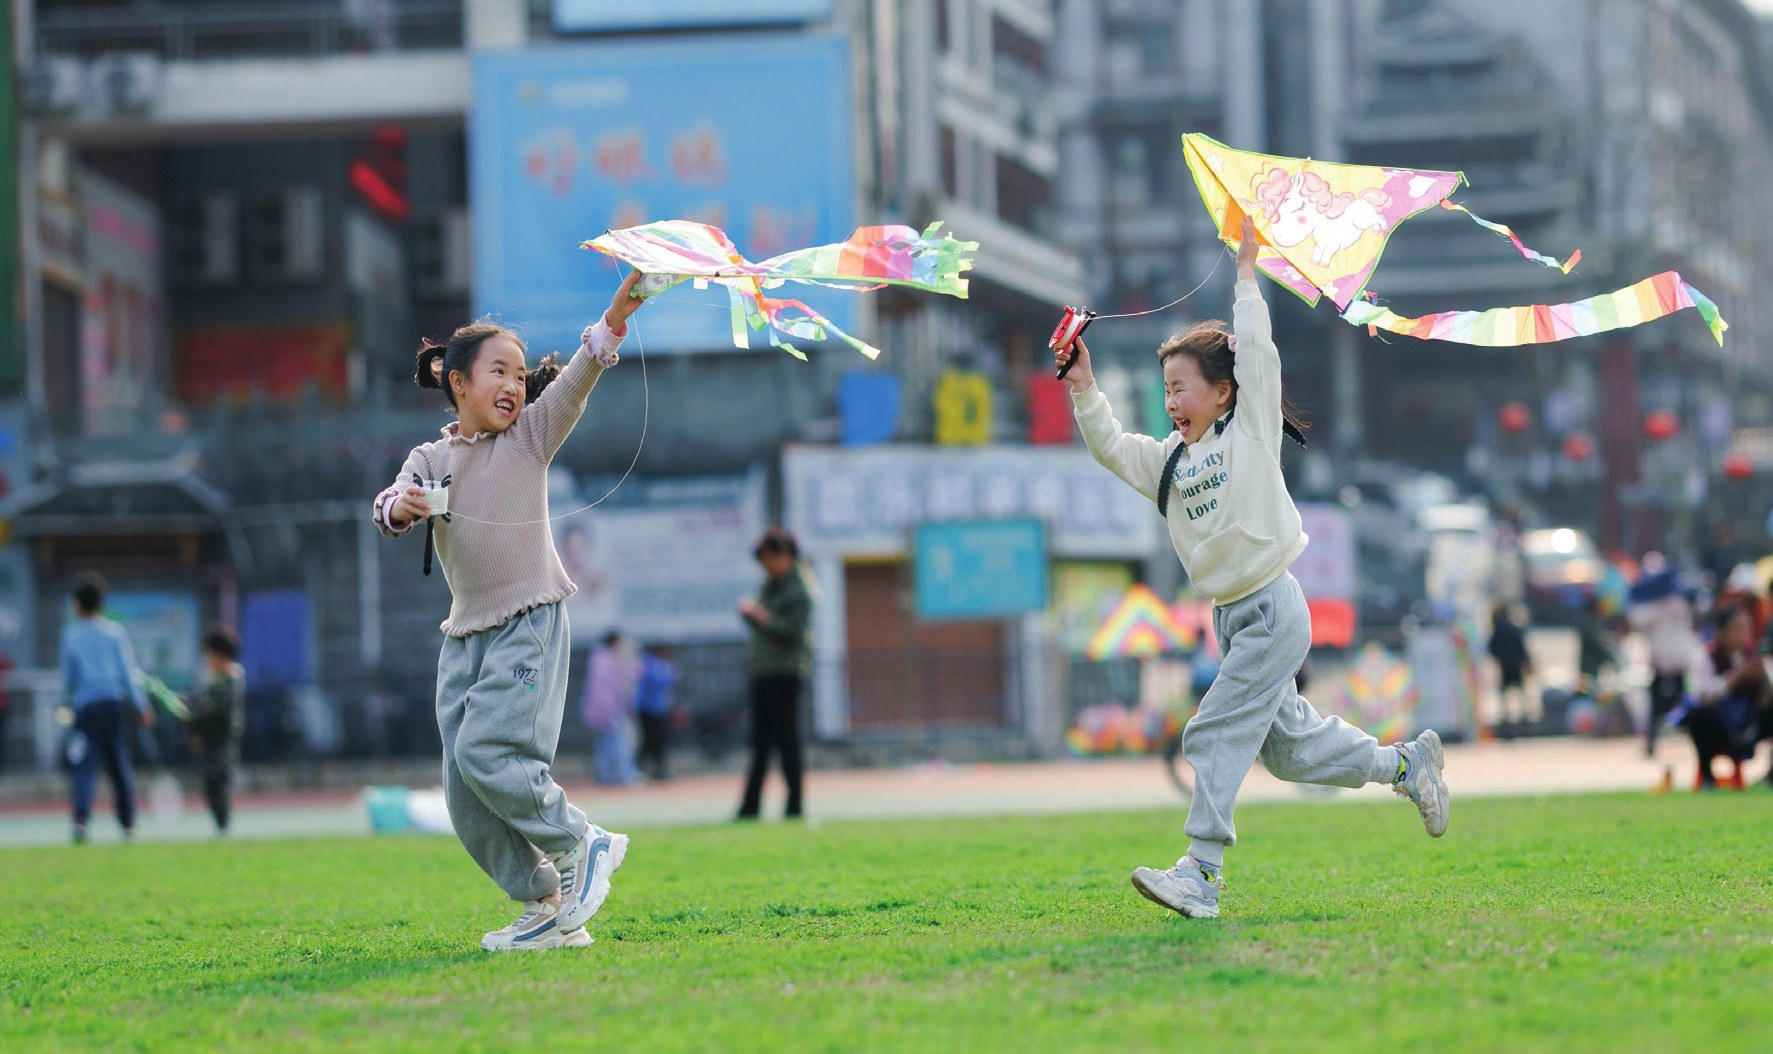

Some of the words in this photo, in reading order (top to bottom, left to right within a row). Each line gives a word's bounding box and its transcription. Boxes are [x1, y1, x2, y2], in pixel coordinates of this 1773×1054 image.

[1181, 471, 1228, 500] ourage
[1186, 498, 1218, 521] Love
[512, 668, 538, 680] 1977
